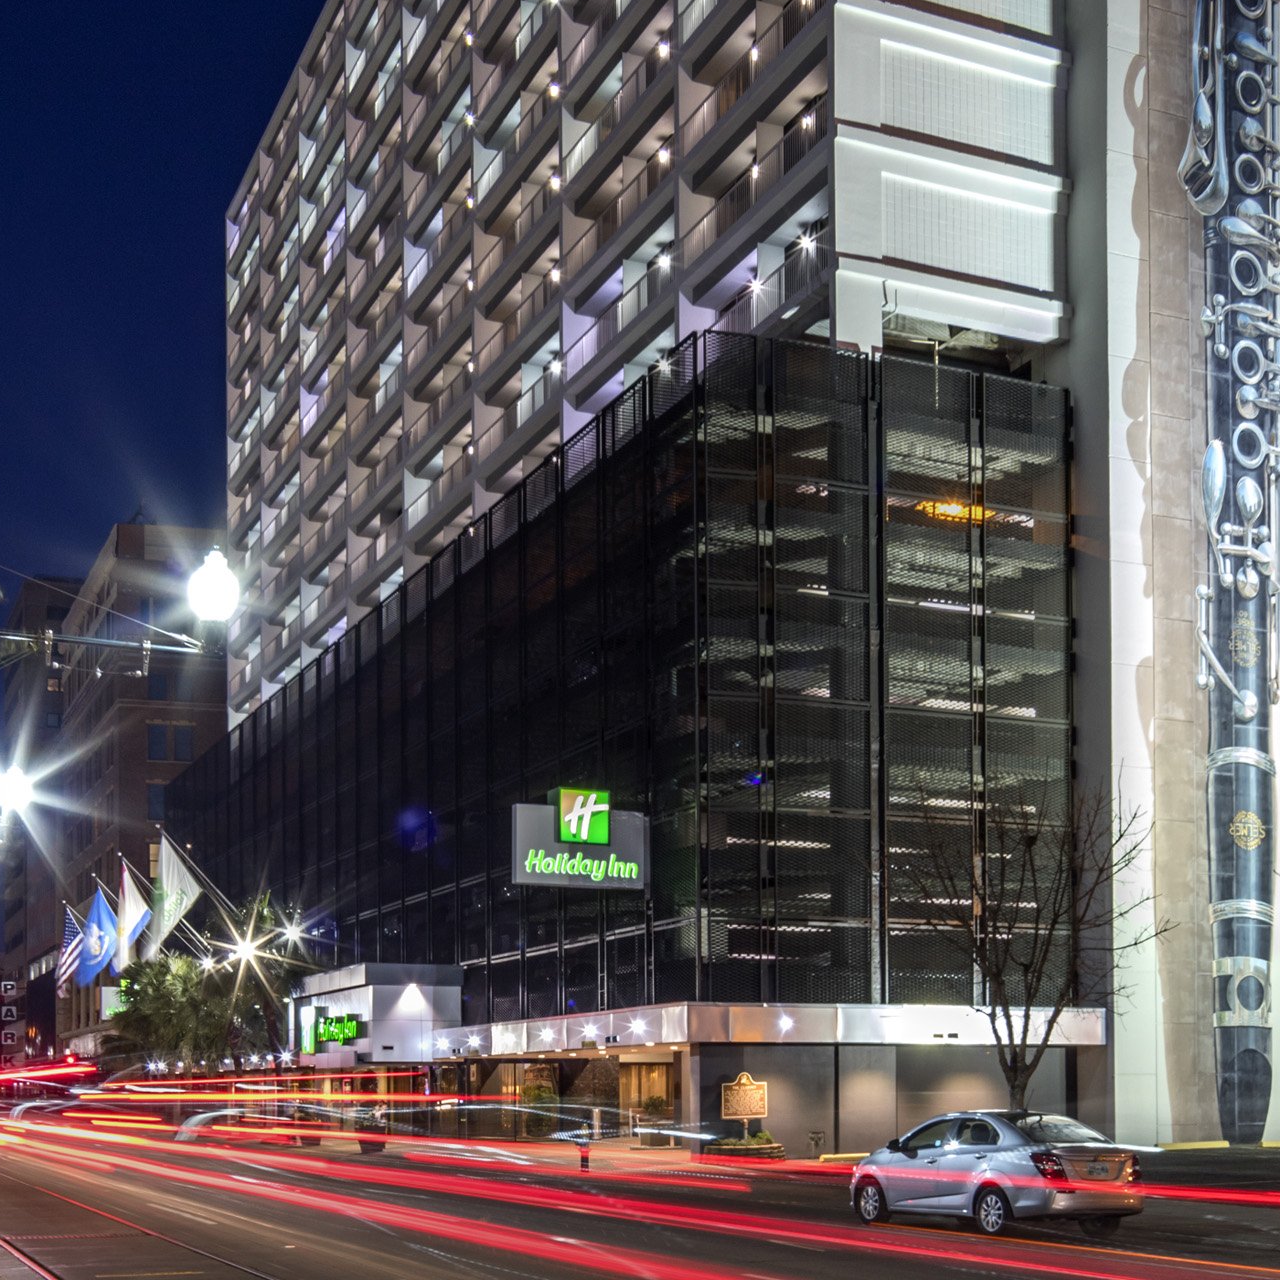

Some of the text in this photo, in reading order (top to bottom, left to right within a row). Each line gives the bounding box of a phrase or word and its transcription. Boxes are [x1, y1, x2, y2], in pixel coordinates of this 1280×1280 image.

[1229, 822, 1266, 839] SELMER
[525, 848, 639, 882] Holiday Inn
